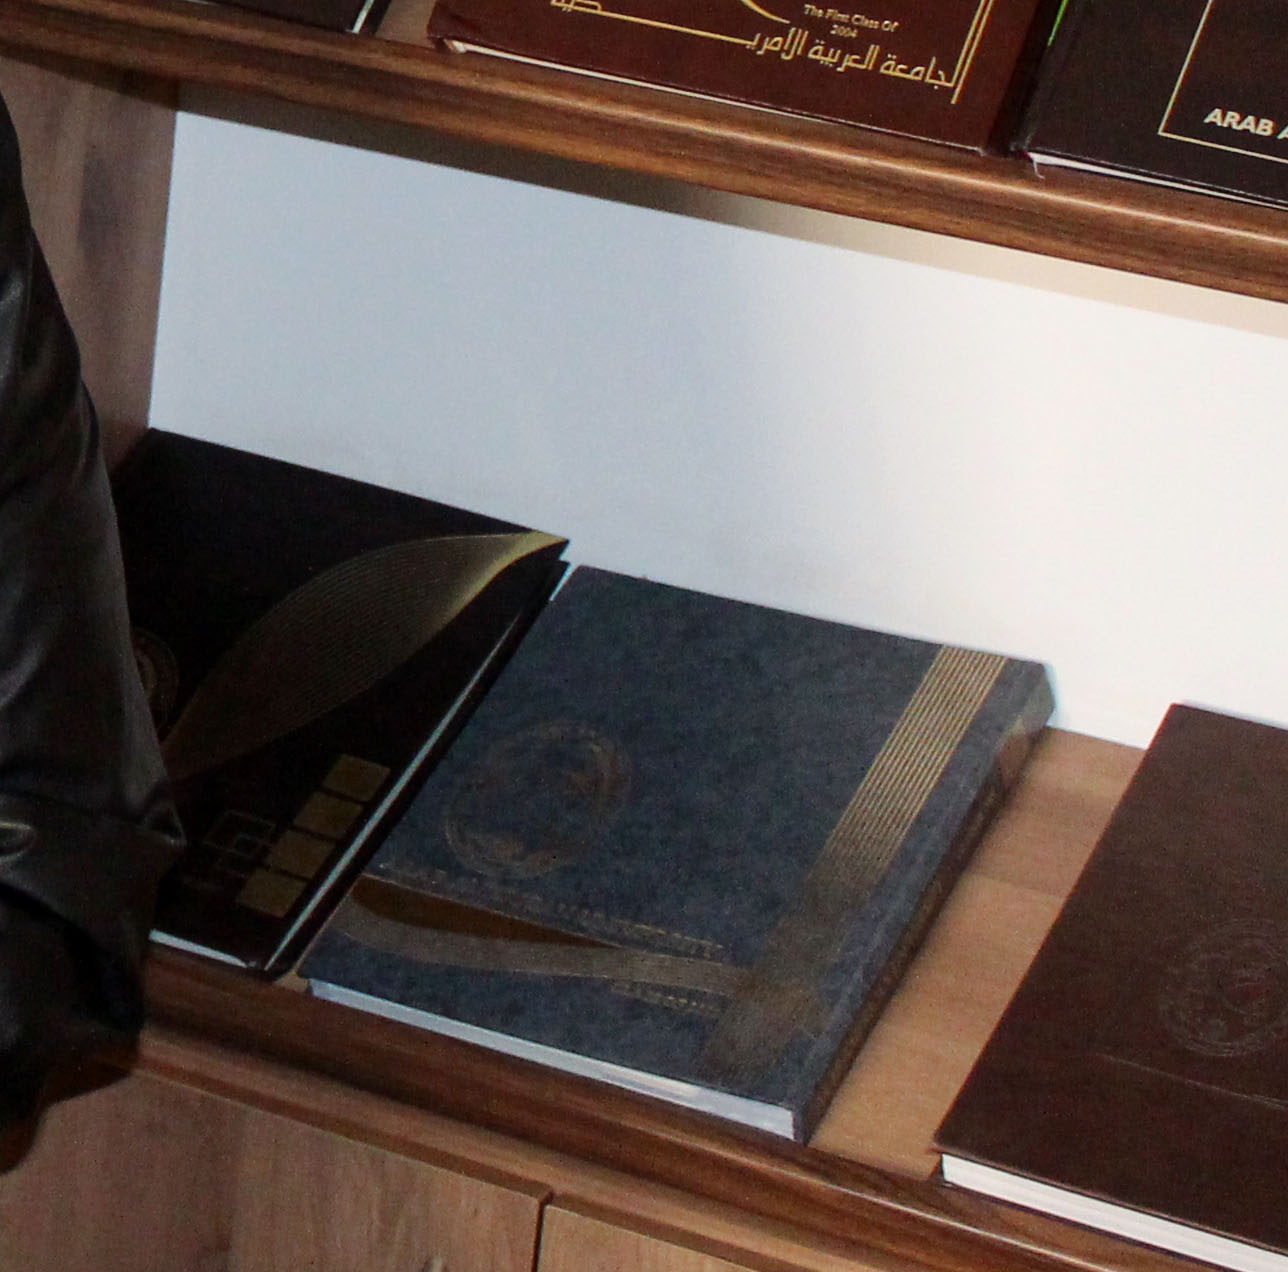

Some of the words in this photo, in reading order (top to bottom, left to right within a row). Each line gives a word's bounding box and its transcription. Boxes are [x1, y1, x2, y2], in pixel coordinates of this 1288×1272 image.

[804, 3, 824, 18] The
[825, 8, 851, 23] First
[851, 14, 881, 30] Class
[881, 19, 899, 33] Of
[807, 37, 880, 73] العربية
[1203, 107, 1275, 137] ARAB
